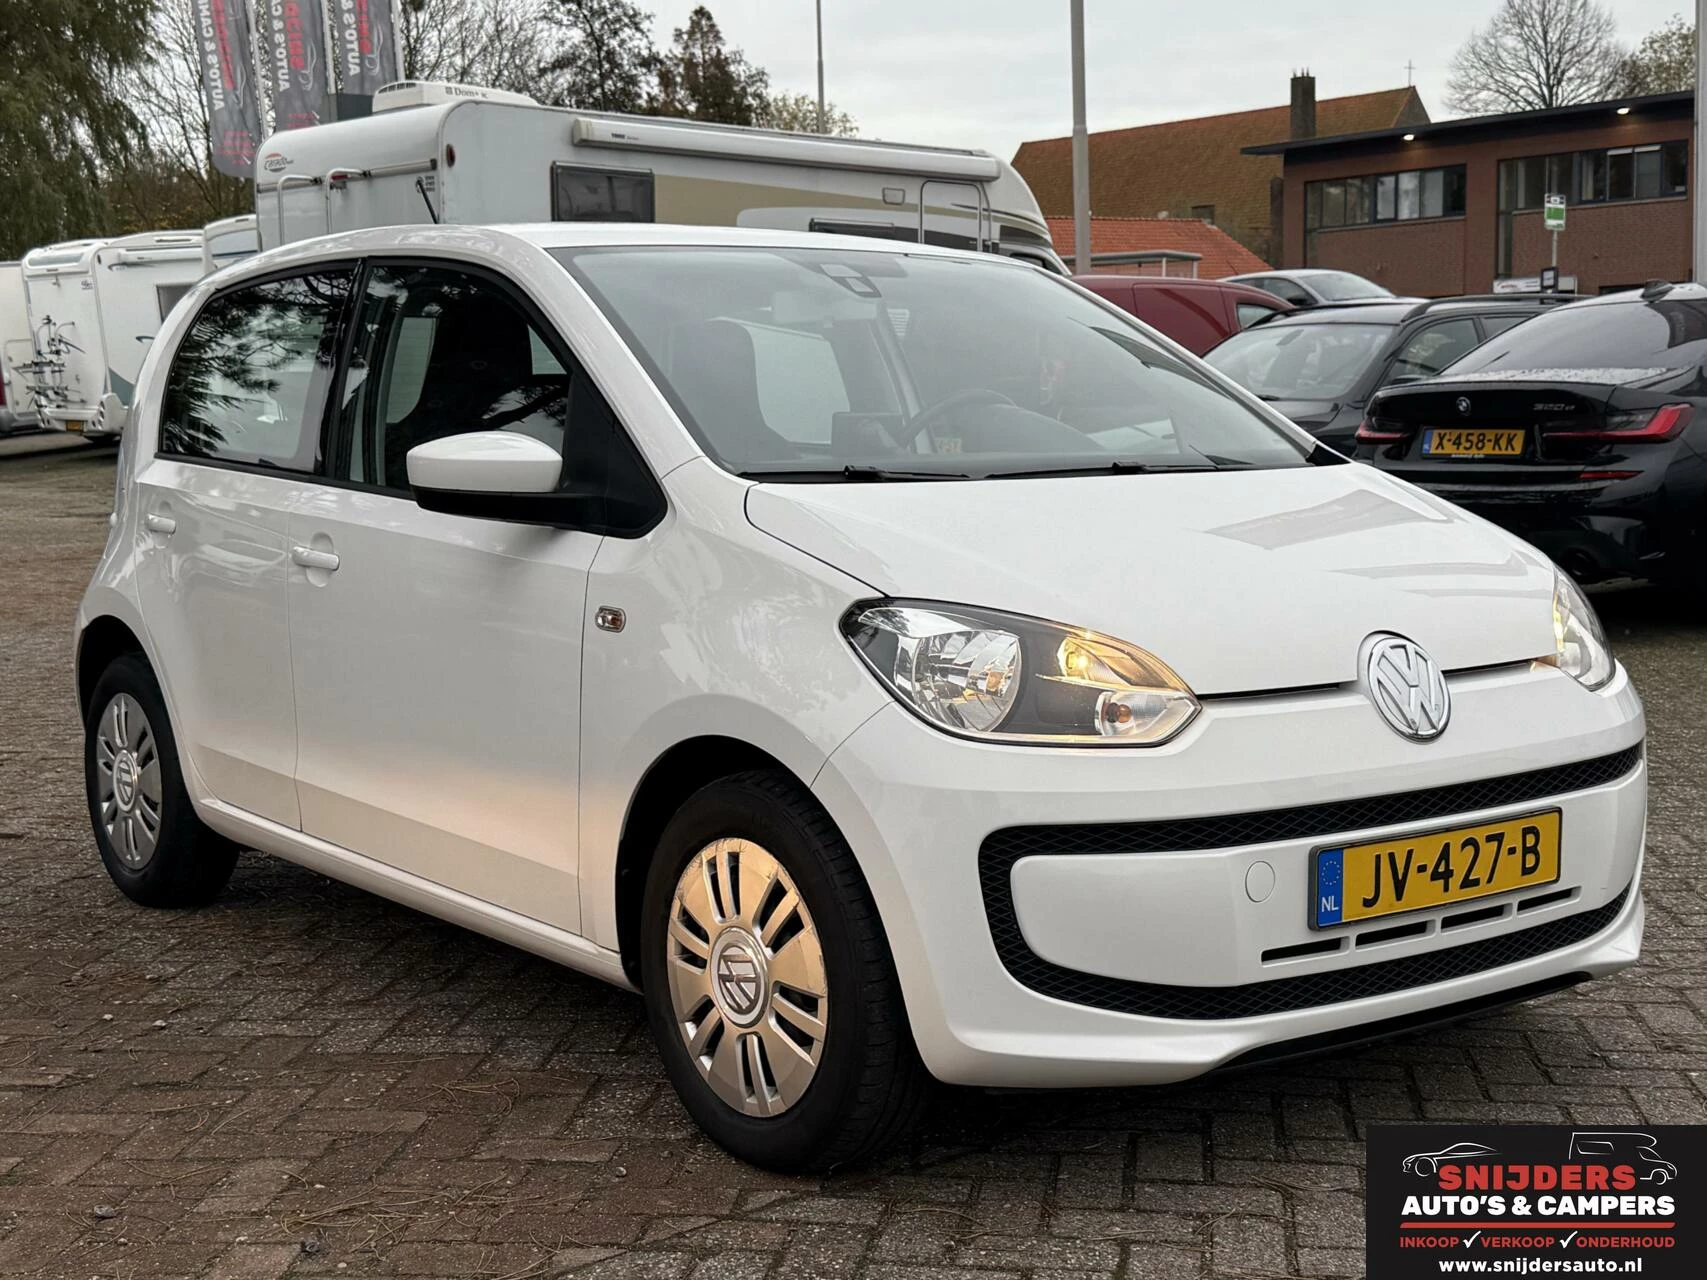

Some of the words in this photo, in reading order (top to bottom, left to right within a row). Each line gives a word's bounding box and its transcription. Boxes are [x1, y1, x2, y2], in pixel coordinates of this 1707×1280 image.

[1435, 432, 1517, 451] X-458-KK
[1362, 825, 1541, 908] JV-427-B
[1321, 896, 1339, 913] NL
